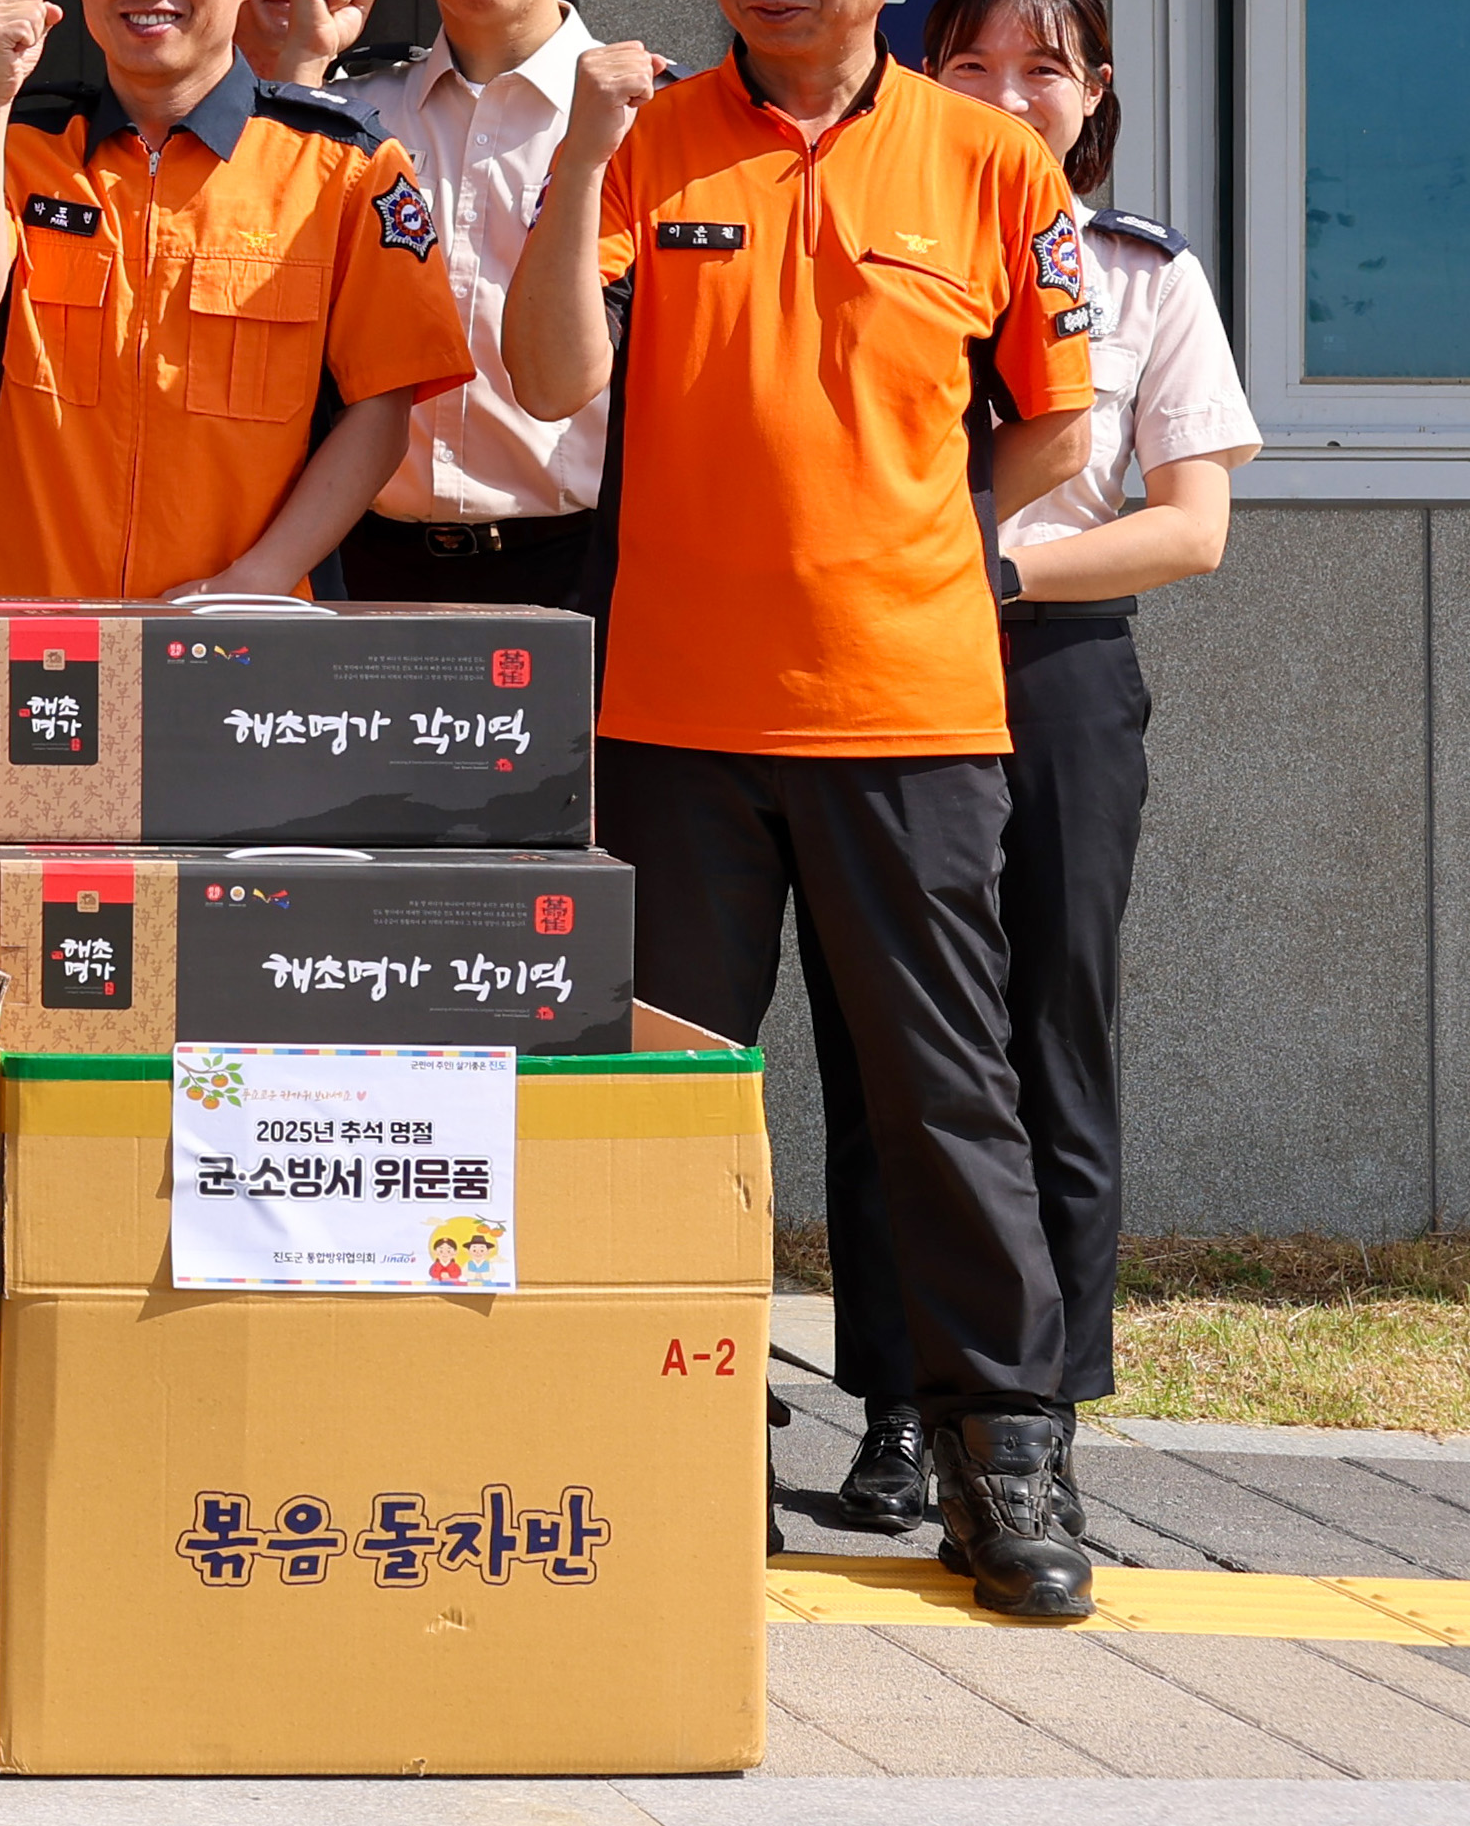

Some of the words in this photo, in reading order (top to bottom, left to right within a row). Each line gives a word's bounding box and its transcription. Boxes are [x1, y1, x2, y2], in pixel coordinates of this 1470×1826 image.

[49, 217, 69, 228] PARK
[26, 695, 80, 716] 해초
[31, 716, 82, 740] 명가
[223, 708, 392, 756] 해초명가
[409, 706, 531, 755] 각미역
[59, 938, 114, 959] 해초
[64, 959, 117, 984] 명가
[260, 953, 432, 1002] 해초명가
[450, 953, 573, 1003] 각미역
[489, 1059, 507, 1069] 진도
[256, 1119, 334, 1144] 2025년
[339, 1120, 384, 1144] 추석
[389, 1121, 433, 1145] 명절
[198, 1155, 362, 1199] 군·소방서
[373, 1158, 490, 1200] 위문품
[272, 1251, 302, 1264] 진도군
[305, 1251, 376, 1265] 통합방위협의회
[661, 1337, 736, 1376] A-2
[180, 1494, 342, 1584] 볶음
[358, 1487, 607, 1584] 돌자반
